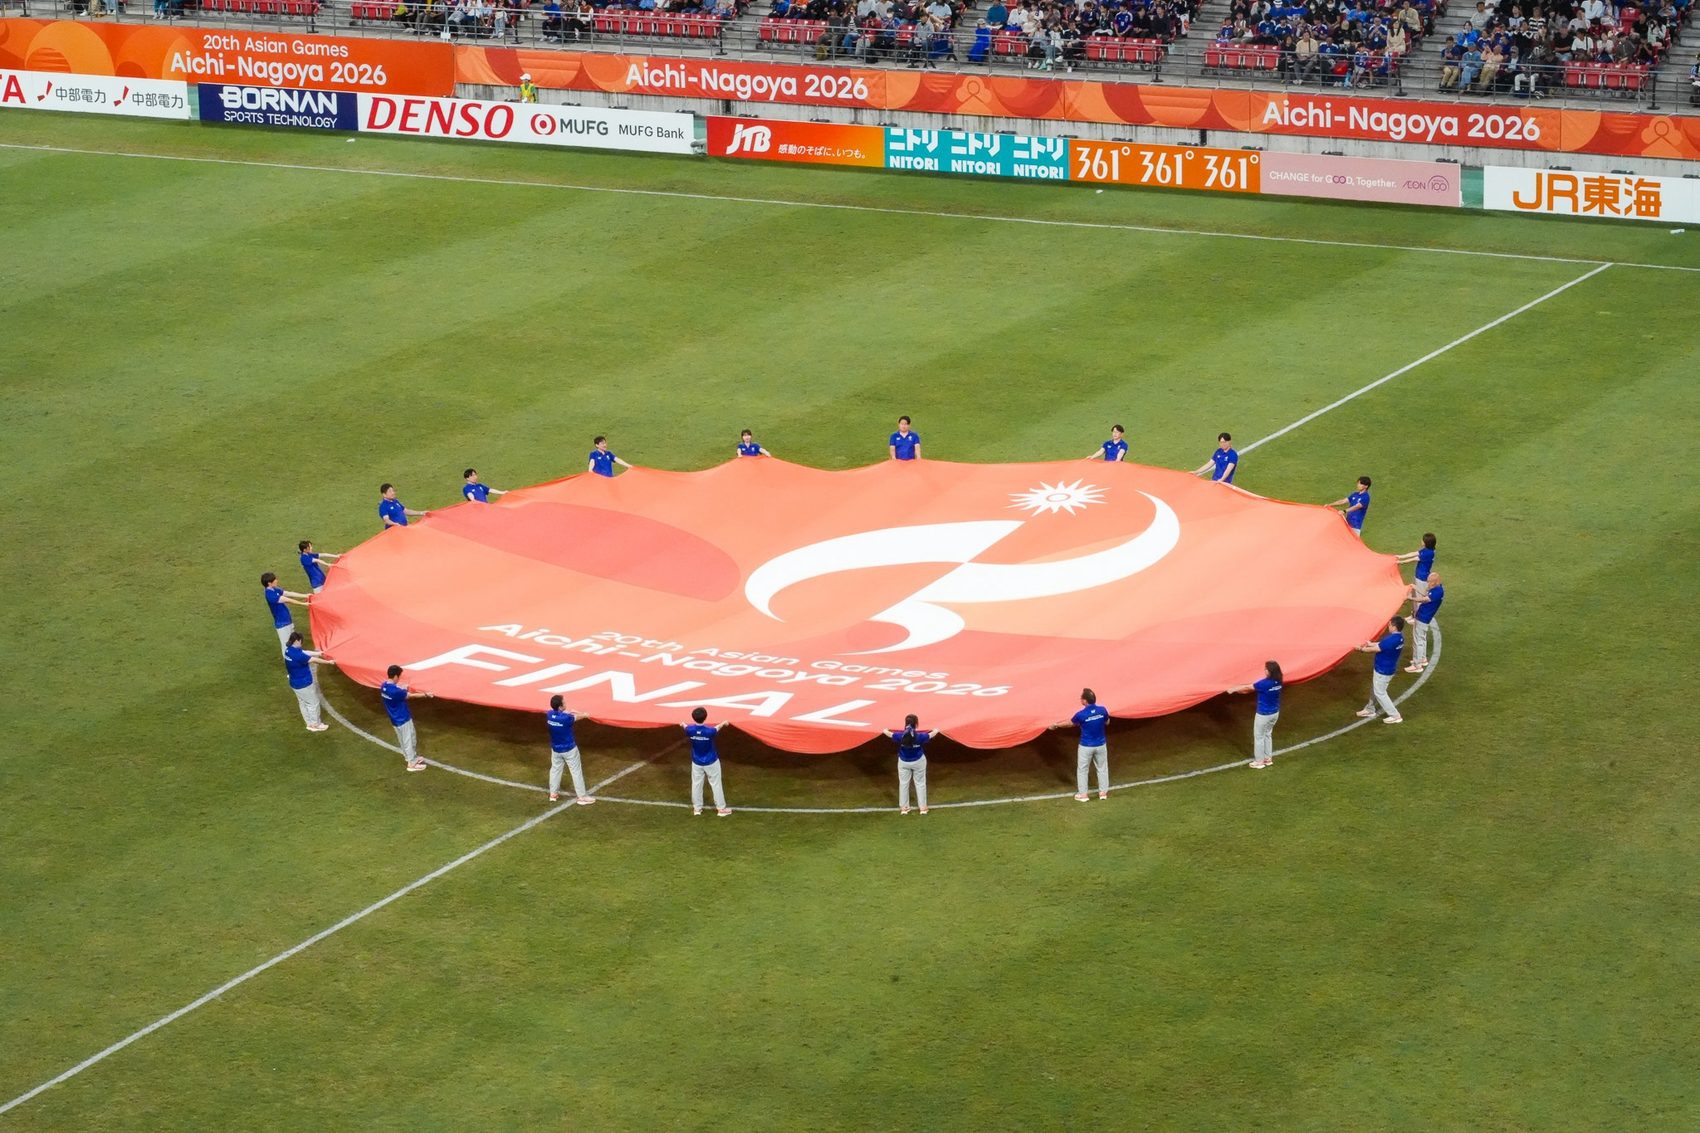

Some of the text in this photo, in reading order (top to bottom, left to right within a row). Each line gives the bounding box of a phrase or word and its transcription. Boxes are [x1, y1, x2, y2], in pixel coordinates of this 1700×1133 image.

[203, 34, 349, 57] 20th Asian Games
[170, 50, 387, 87] Aichi-Nagoya 2026
[626, 62, 869, 101] Aichi-Nagoya 2026
[0, 74, 26, 104] A
[55, 87, 106, 104] 中部電力
[132, 92, 183, 109] 中部電力
[219, 85, 338, 115] BORNAN
[224, 110, 338, 129] SPORTS TECHNOLOGY
[366, 97, 514, 139] DENSO
[559, 118, 609, 136] MUFG
[618, 124, 684, 140] MUFG Bank
[1262, 99, 1541, 142] Aichi-Nagoya 2026
[725, 123, 772, 155] JTB
[889, 128, 1064, 161] ニトリ ニトリ ニトリ
[889, 155, 1064, 179] NITORI NITORI NITORI
[1269, 170, 1309, 183] CHANGE
[1311, 173, 1323, 183] for
[1356, 176, 1397, 188] Together.
[1512, 172, 1662, 218] JR東海
[477, 623, 1014, 697] Aichi-Nagoya 2026
[591, 631, 950, 679] 20th Asian Games
[402, 643, 877, 727] FINAL
